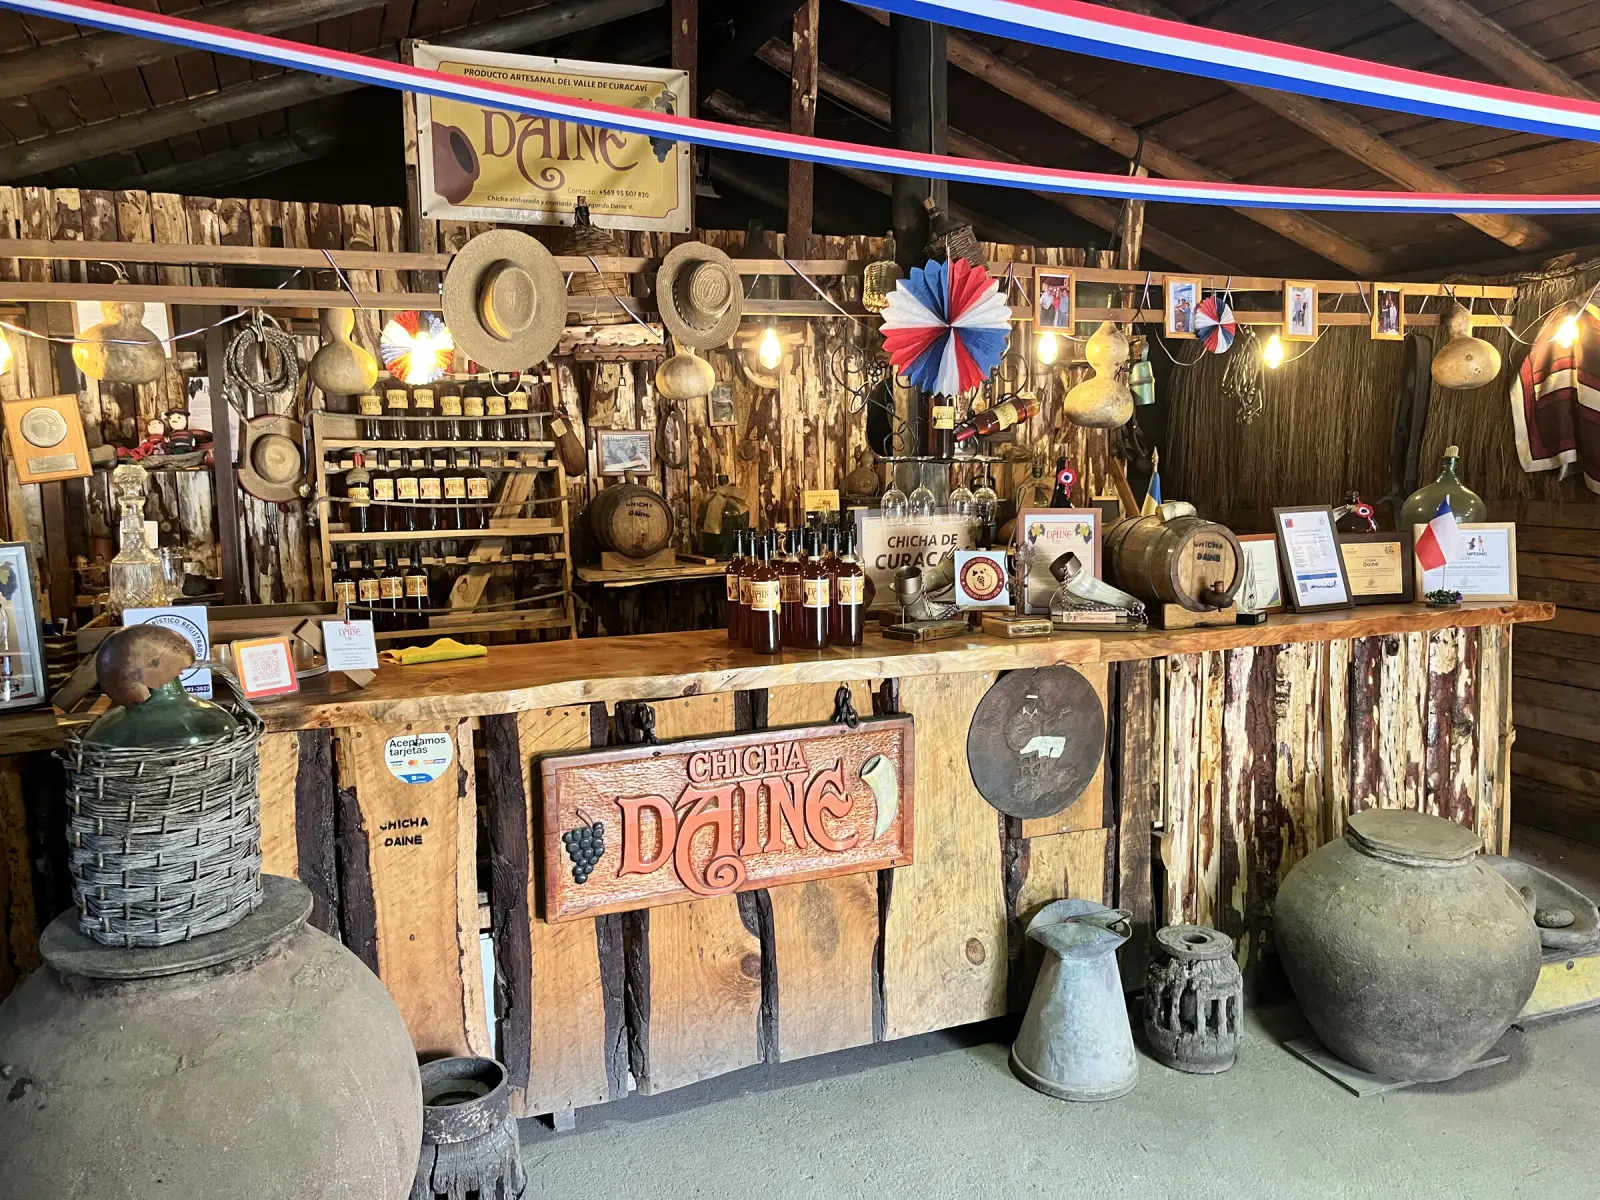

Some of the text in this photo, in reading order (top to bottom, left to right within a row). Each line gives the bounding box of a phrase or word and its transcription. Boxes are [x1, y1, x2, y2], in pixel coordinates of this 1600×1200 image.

[463, 68, 508, 80] PRODUCTO
[510, 73, 555, 84] ARTESANAL
[558, 78, 571, 86] DEL
[573, 80, 595, 88] VALLE
[609, 82, 648, 92] CURACAVÍ
[480, 108, 639, 191] DAINE
[887, 533, 959, 548] CHICHA DE
[875, 551, 952, 570] CURACA
[389, 746, 428, 757] tarjetas
[688, 741, 808, 783] CHICHA
[615, 757, 860, 896] DAINE
[384, 835, 423, 847] DAINE
